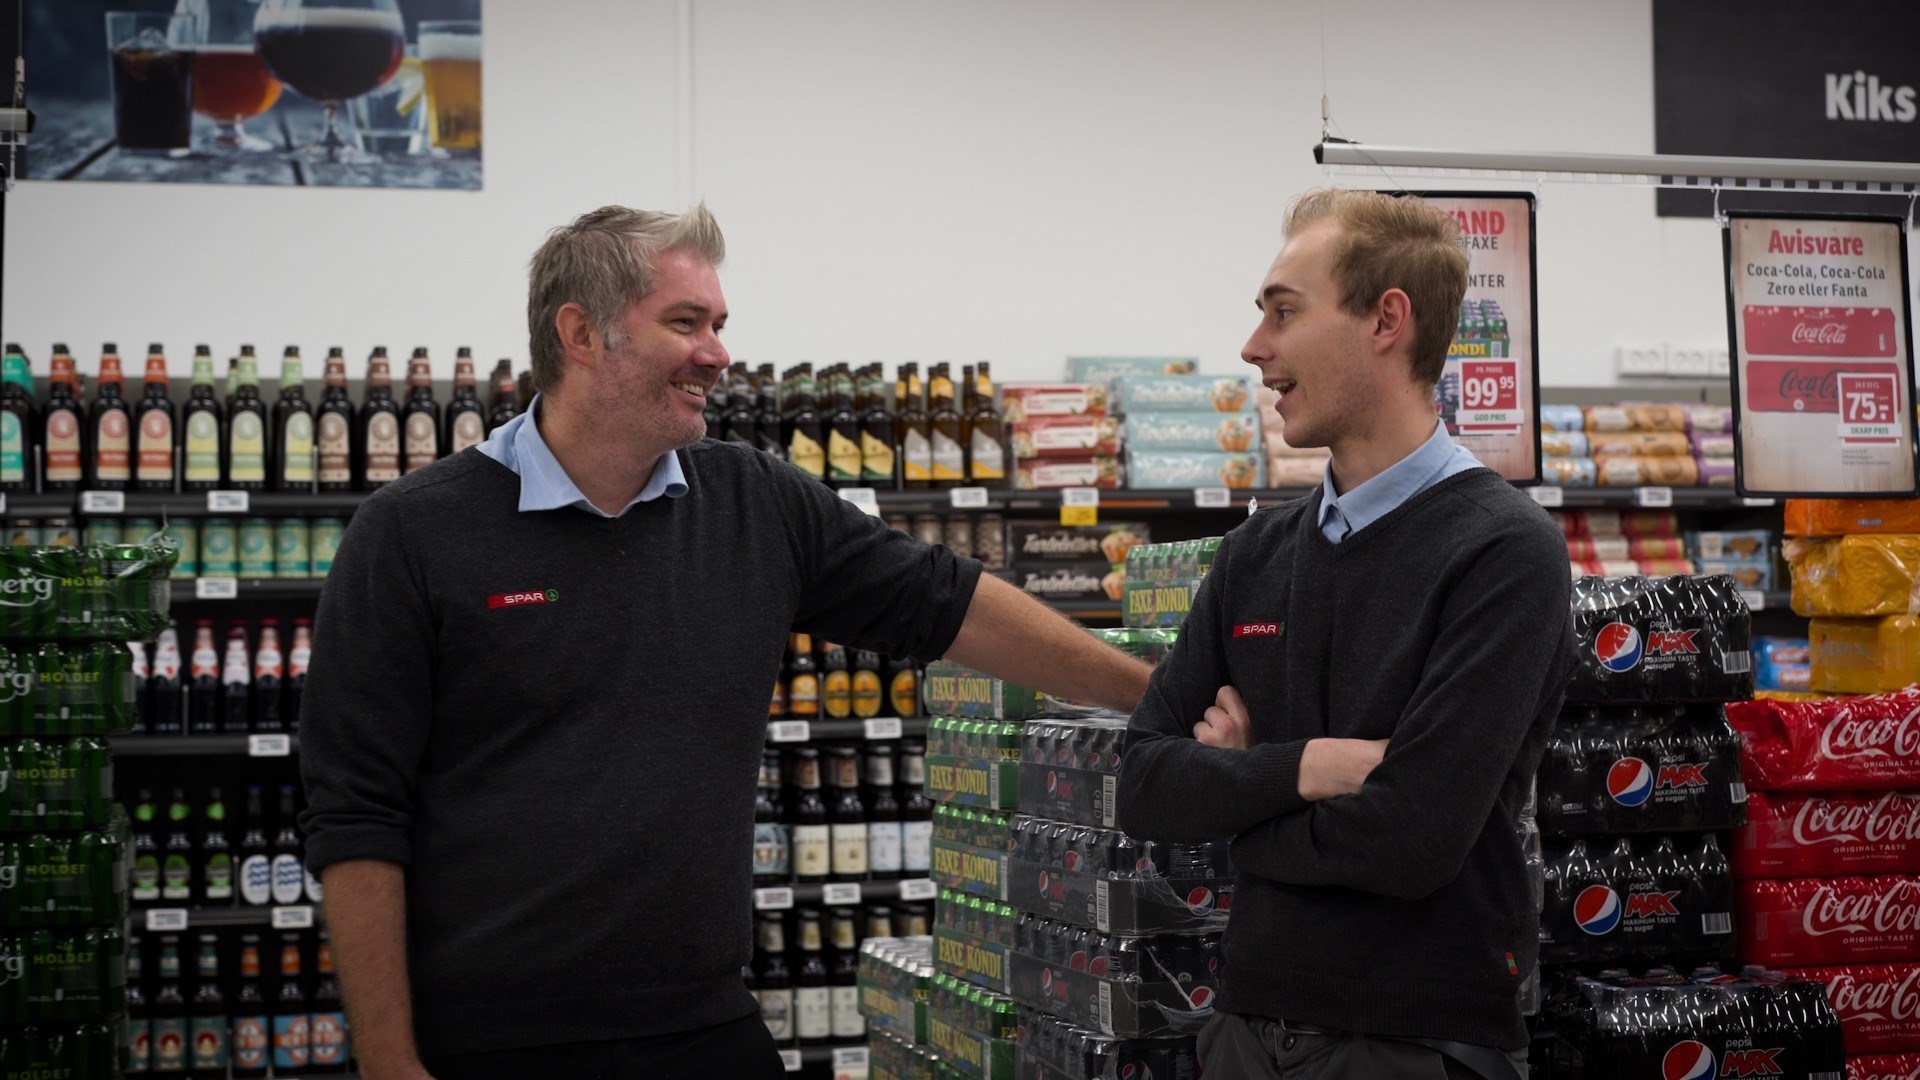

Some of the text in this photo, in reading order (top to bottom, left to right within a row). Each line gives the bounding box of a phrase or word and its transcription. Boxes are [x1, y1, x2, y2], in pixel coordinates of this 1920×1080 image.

[1825, 70, 1918, 123] Kiks
[1450, 210, 1505, 235] AND
[1465, 236, 1498, 250] FAXE
[1768, 229, 1864, 256] Avisvare
[1747, 263, 1886, 280] Coca-Cola, Coca-Cola
[1469, 274, 1505, 288] NTER
[1767, 282, 1868, 298] Zero eller Fanta
[1792, 322, 1849, 344] Coca-Cola
[1447, 343, 1486, 356] ONDI
[1474, 413, 1506, 422] GOD PRIS
[1851, 427, 1889, 435] SKARP PRIS
[0, 575, 53, 601] erg
[504, 592, 544, 604] SPAR
[1129, 586, 1190, 614] FAXE KONDI
[1243, 624, 1276, 634] SPAR
[1645, 628, 1701, 656] MAX
[39, 671, 101, 683] HOLDET
[932, 676, 991, 704] FAXE KONDI
[1821, 705, 1920, 760] Coca-C
[1863, 760, 1905, 768] ORIGINAL
[16, 767, 78, 779] HOLDET
[930, 765, 988, 796] FAXE KONDI
[1655, 761, 1710, 790] MAX
[1655, 786, 1706, 797] MAXIMUM TASTE
[1793, 791, 1920, 846] Coca-Col
[1833, 844, 1907, 854] ORIGINAL TASTE
[26, 864, 87, 875] HOLDET
[934, 846, 998, 885] FAXE KONDI
[1624, 890, 1682, 918] MAX
[1803, 879, 1920, 936] Coca-Co
[1623, 918, 1656, 926] MAXIMUM
[1843, 936, 1884, 944] ORIGINAL
[32, 952, 95, 965] HOLDET
[938, 936, 1002, 980] FAXE KONDI
[1826, 967, 1920, 1023] Coca-C
[1859, 1024, 1902, 1033] ORIGINAL
[931, 1017, 981, 1068] FAXE KONDI
[1726, 1038, 1753, 1049] pepsi
[1720, 1047, 1787, 1077] MAX
